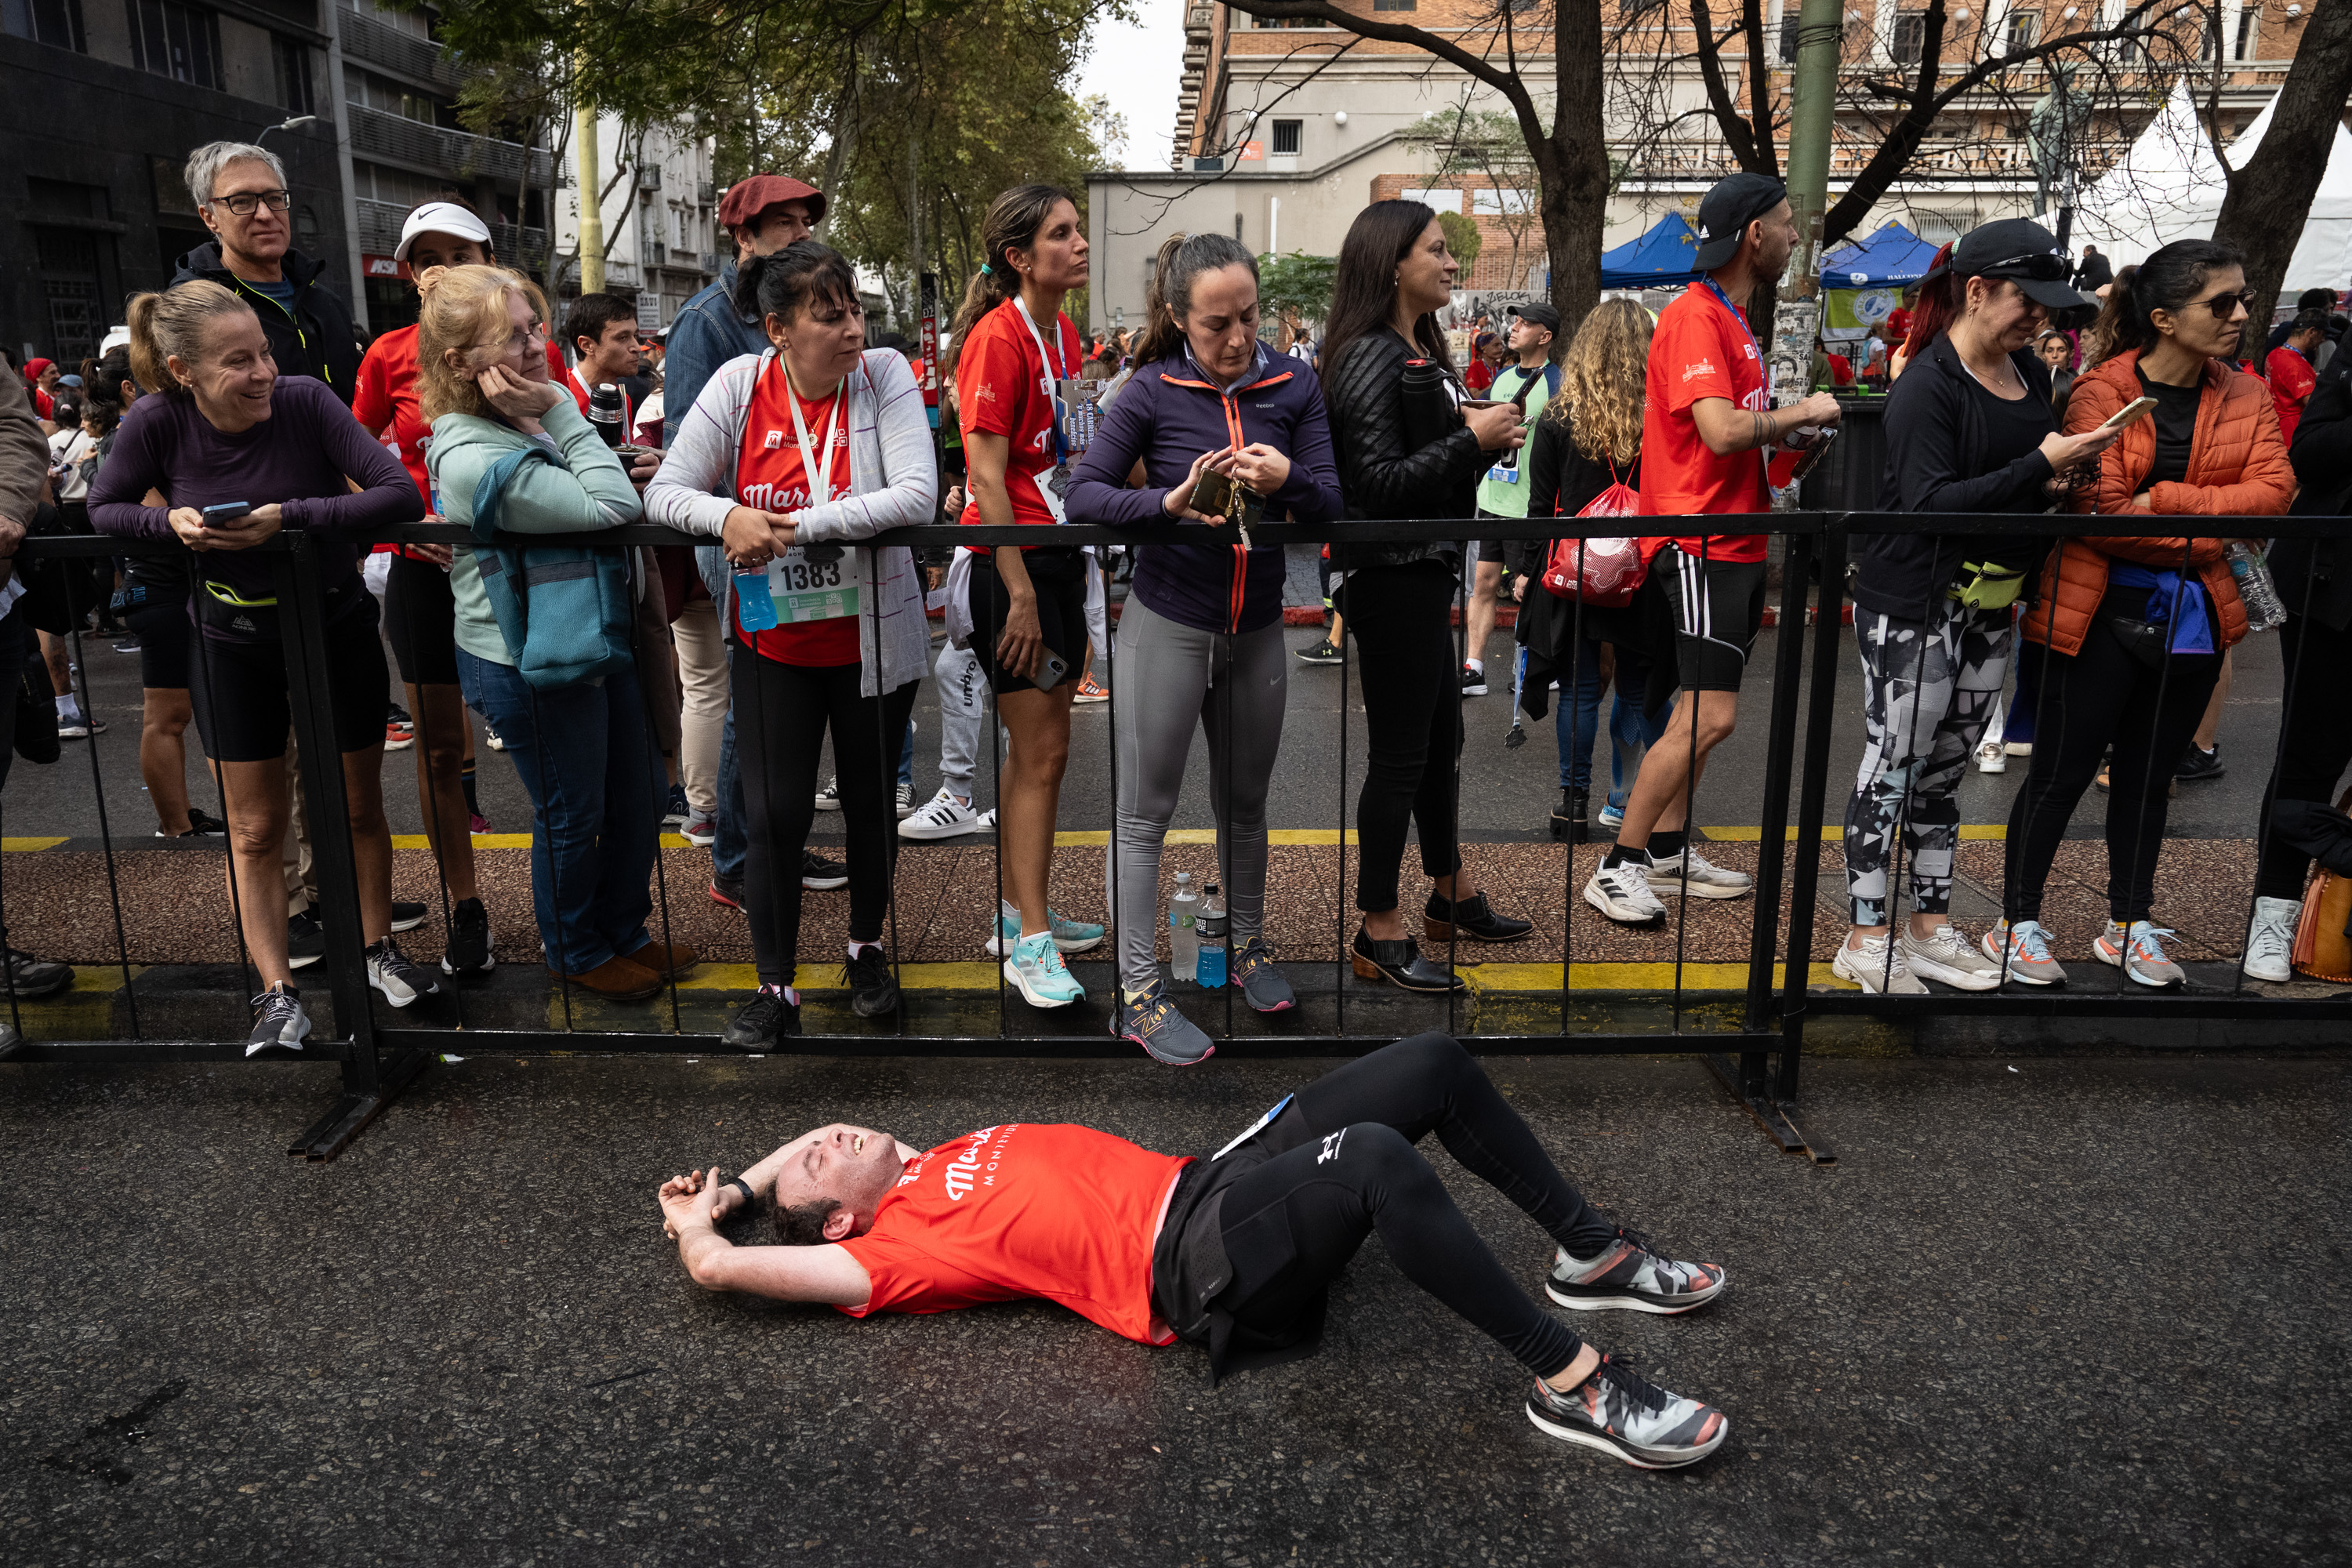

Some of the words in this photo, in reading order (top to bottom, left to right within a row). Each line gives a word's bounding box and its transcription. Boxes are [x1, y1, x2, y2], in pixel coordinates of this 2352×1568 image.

[370, 260, 398, 275] ACSA
[781, 562, 841, 591] 1383
[960, 660, 977, 706] umbro
[982, 1123, 1020, 1186] MONTEVIDE
